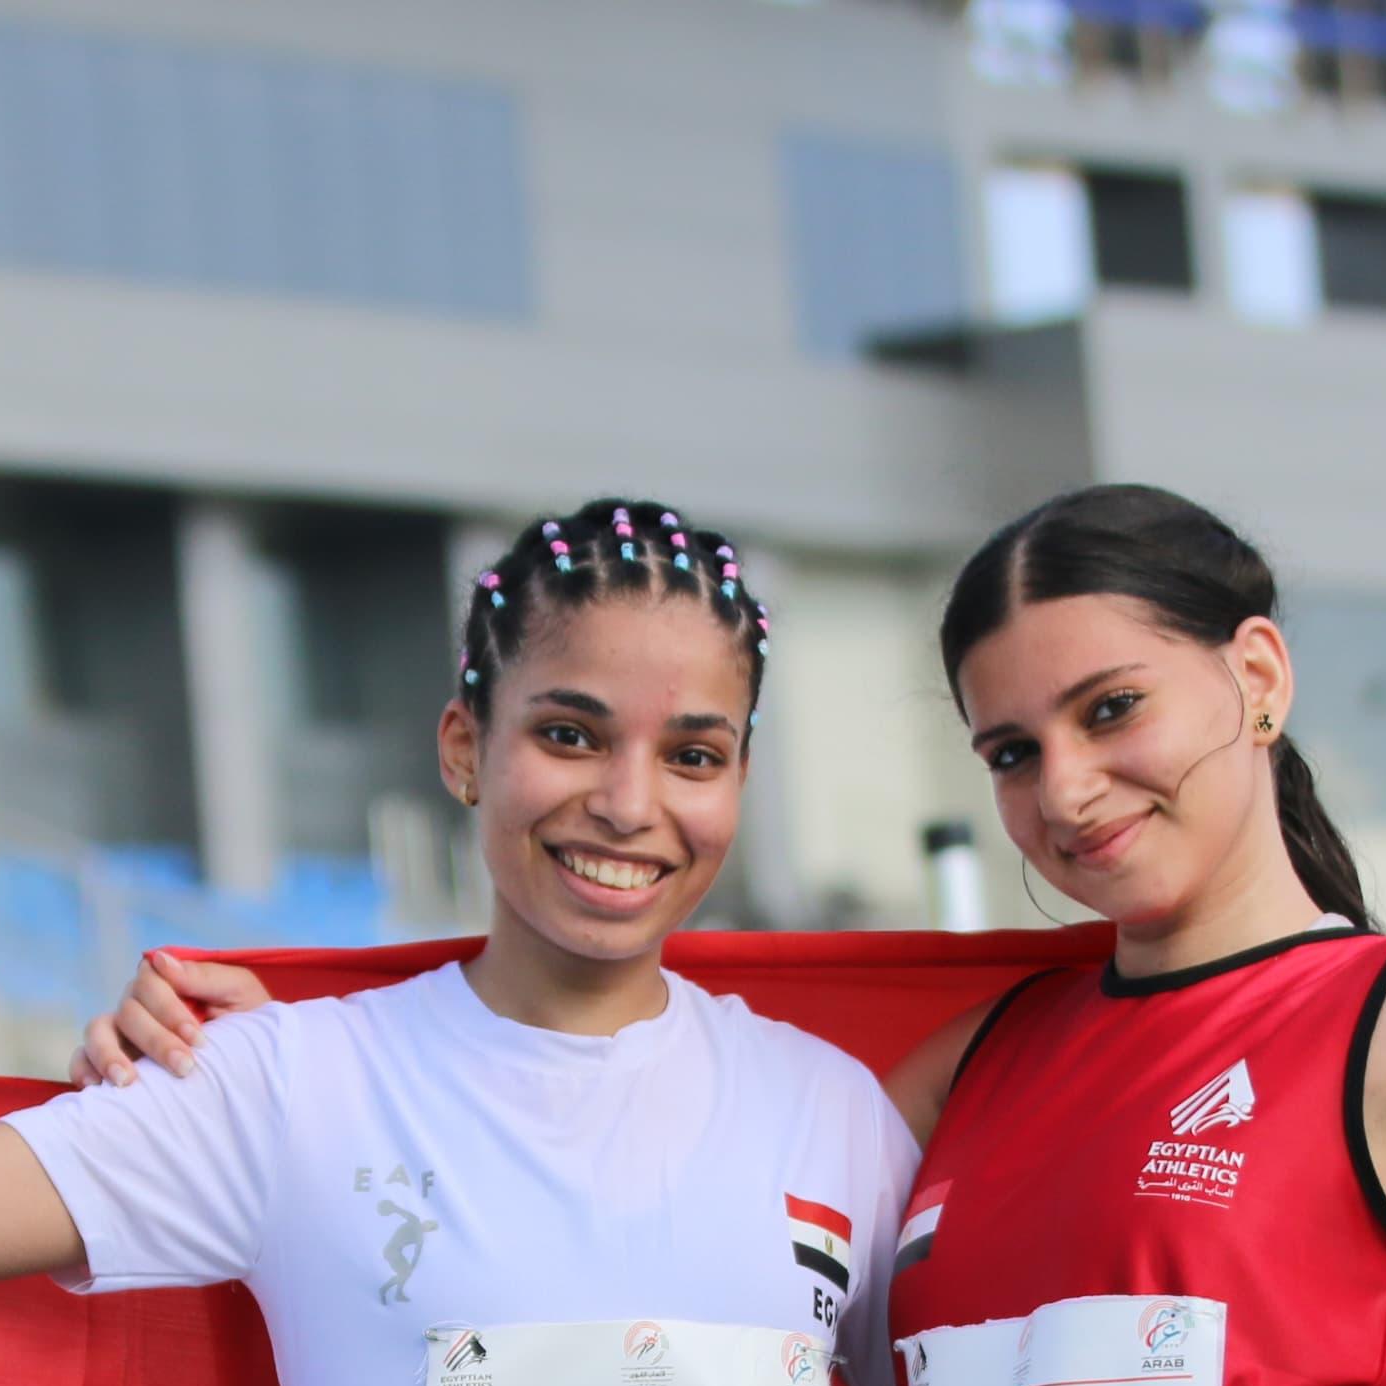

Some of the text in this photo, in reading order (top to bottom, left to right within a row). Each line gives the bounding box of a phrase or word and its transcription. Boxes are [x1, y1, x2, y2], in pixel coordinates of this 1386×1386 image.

[1148, 1141, 1245, 1168] EGYPTIAN
[1141, 1159, 1238, 1185] ATHLETICS
[1142, 1358, 1184, 1369] ARAB
[440, 1374, 492, 1384] EGYPTIAN
